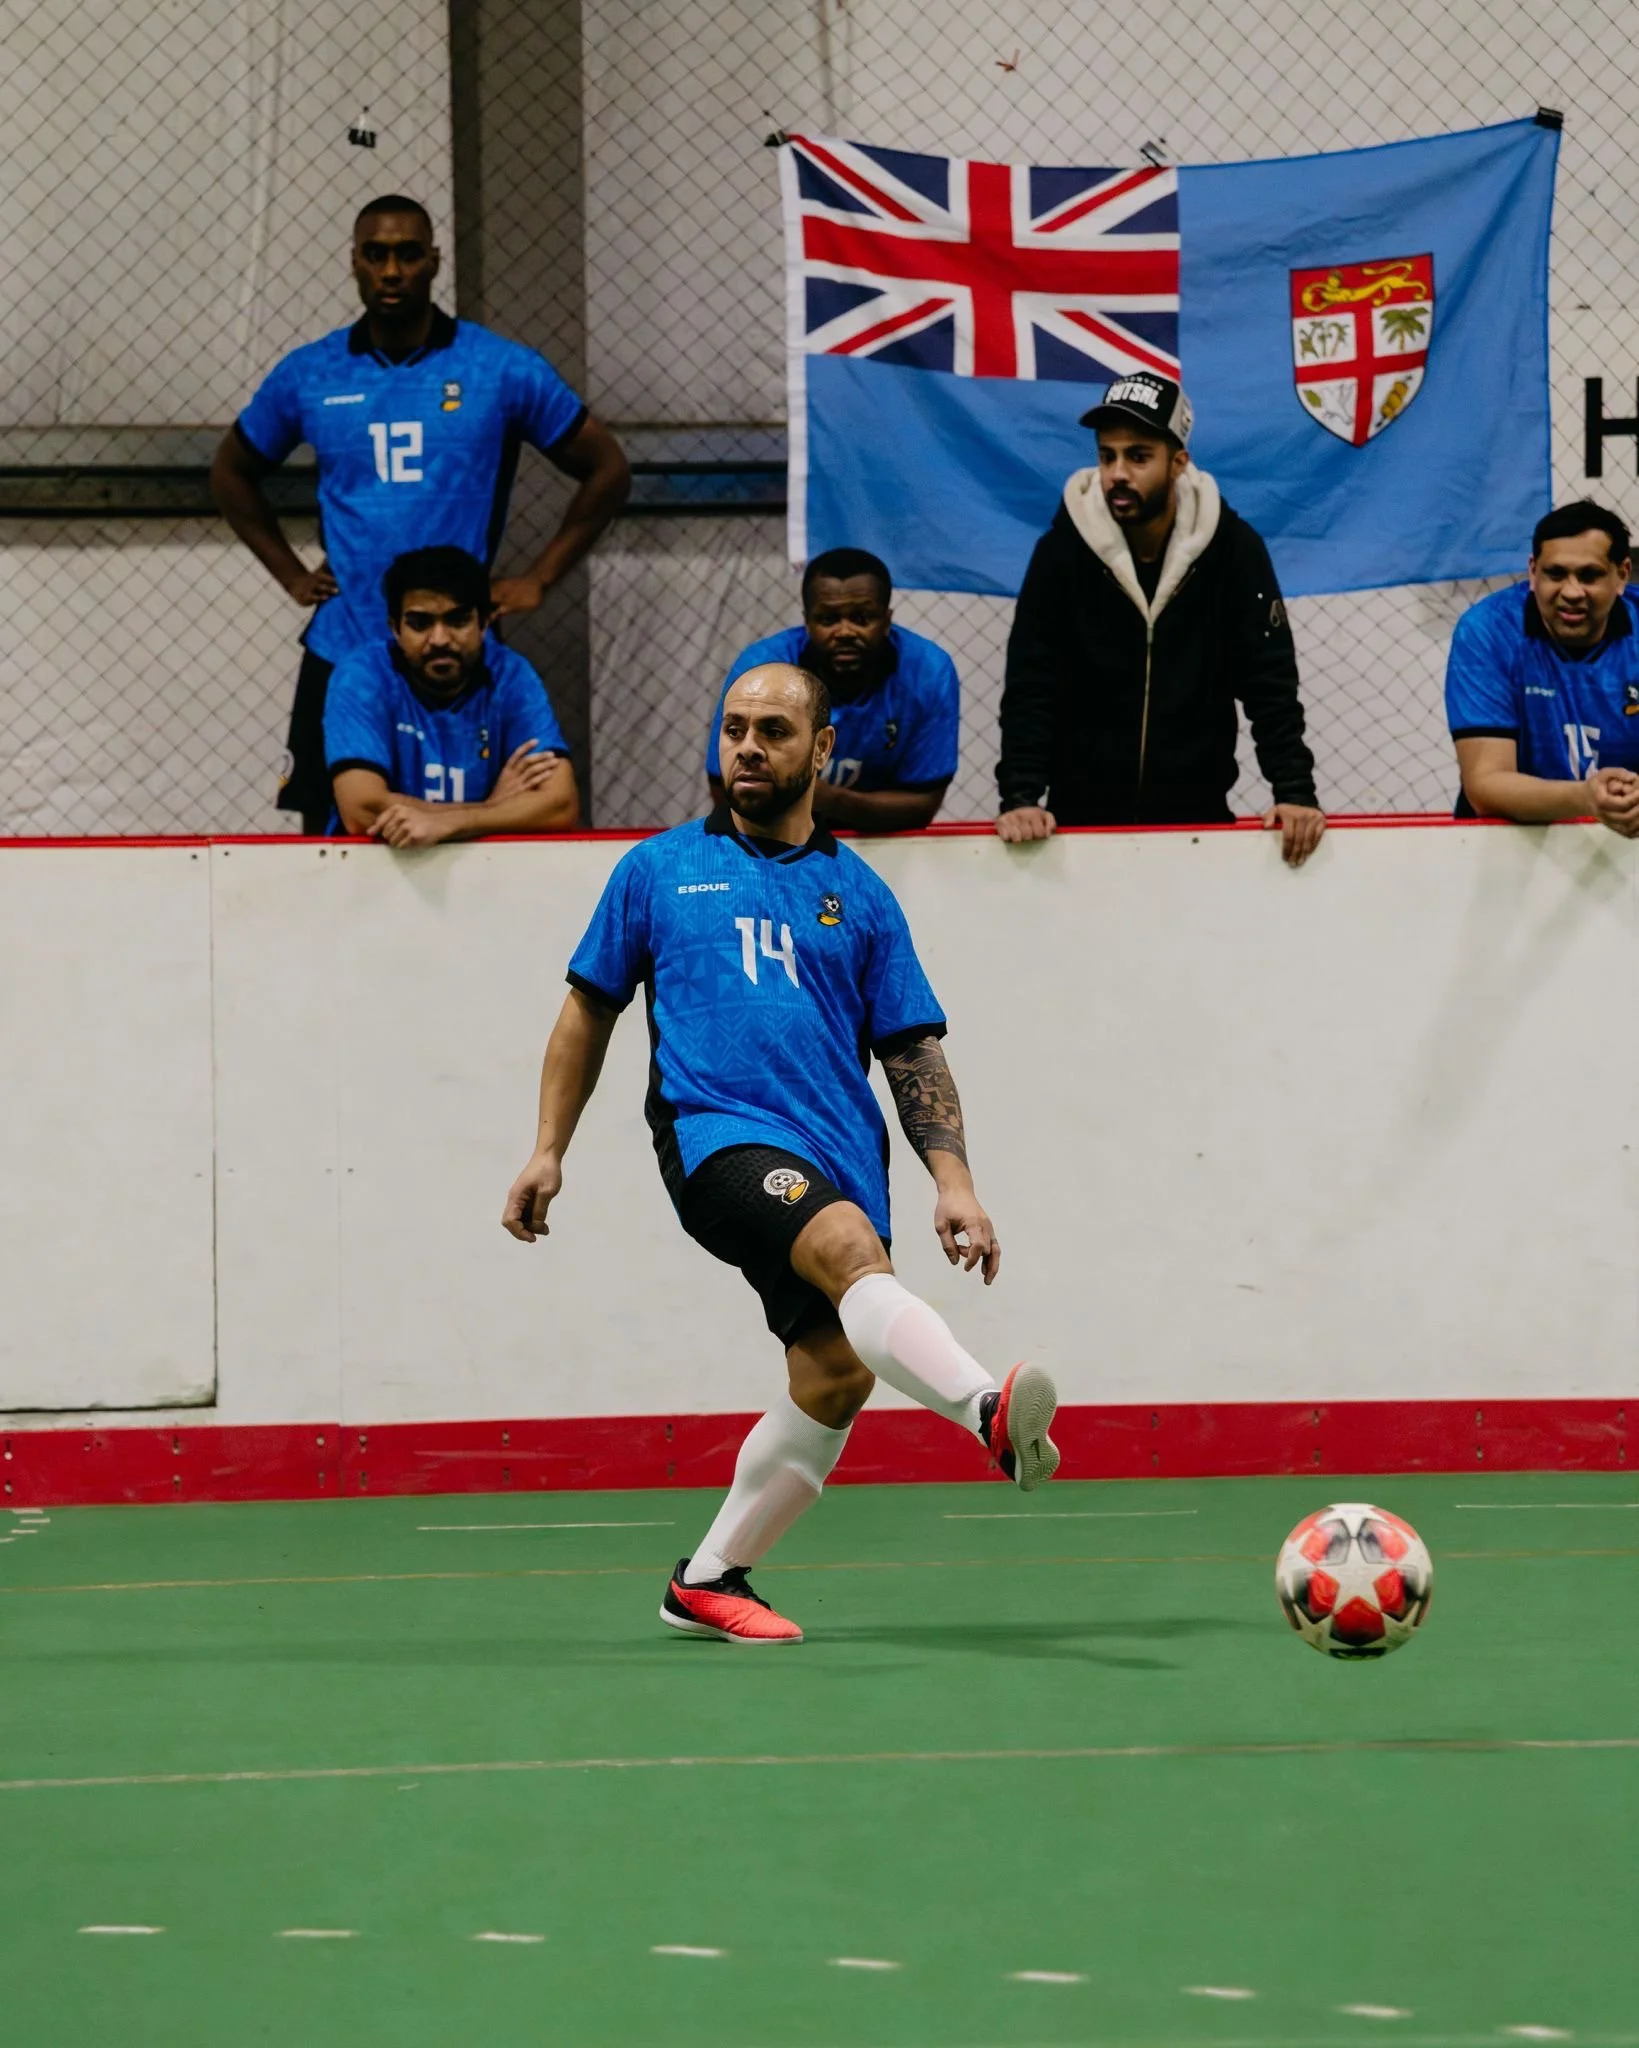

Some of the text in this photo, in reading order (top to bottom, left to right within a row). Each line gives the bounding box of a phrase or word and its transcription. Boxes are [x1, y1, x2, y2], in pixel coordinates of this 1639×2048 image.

[1104, 381, 1160, 410] FUTSAL
[368, 421, 424, 483] 12
[1584, 376, 1639, 478] H
[1563, 723, 1601, 781] 15
[424, 763, 466, 803] 21
[677, 882, 731, 895] ESQUE
[734, 916, 800, 990] 14
